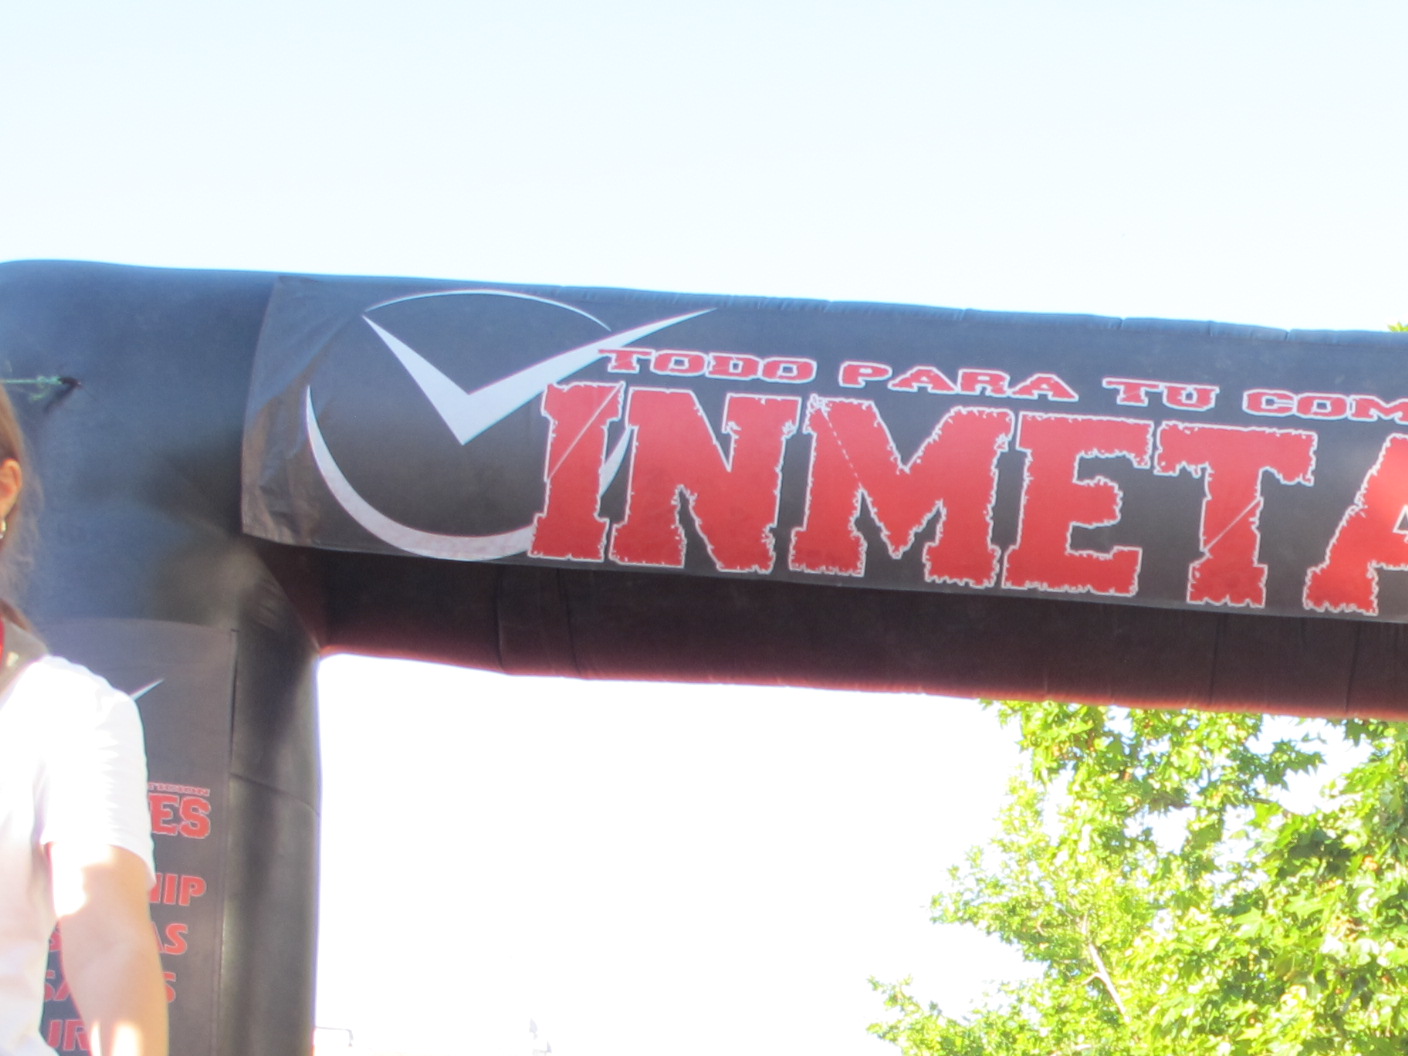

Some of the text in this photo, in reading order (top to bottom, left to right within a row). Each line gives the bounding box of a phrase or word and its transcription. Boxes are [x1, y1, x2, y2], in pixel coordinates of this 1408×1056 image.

[598, 348, 817, 385] TODO
[838, 361, 1079, 401] PARA
[1103, 377, 1220, 411] TU
